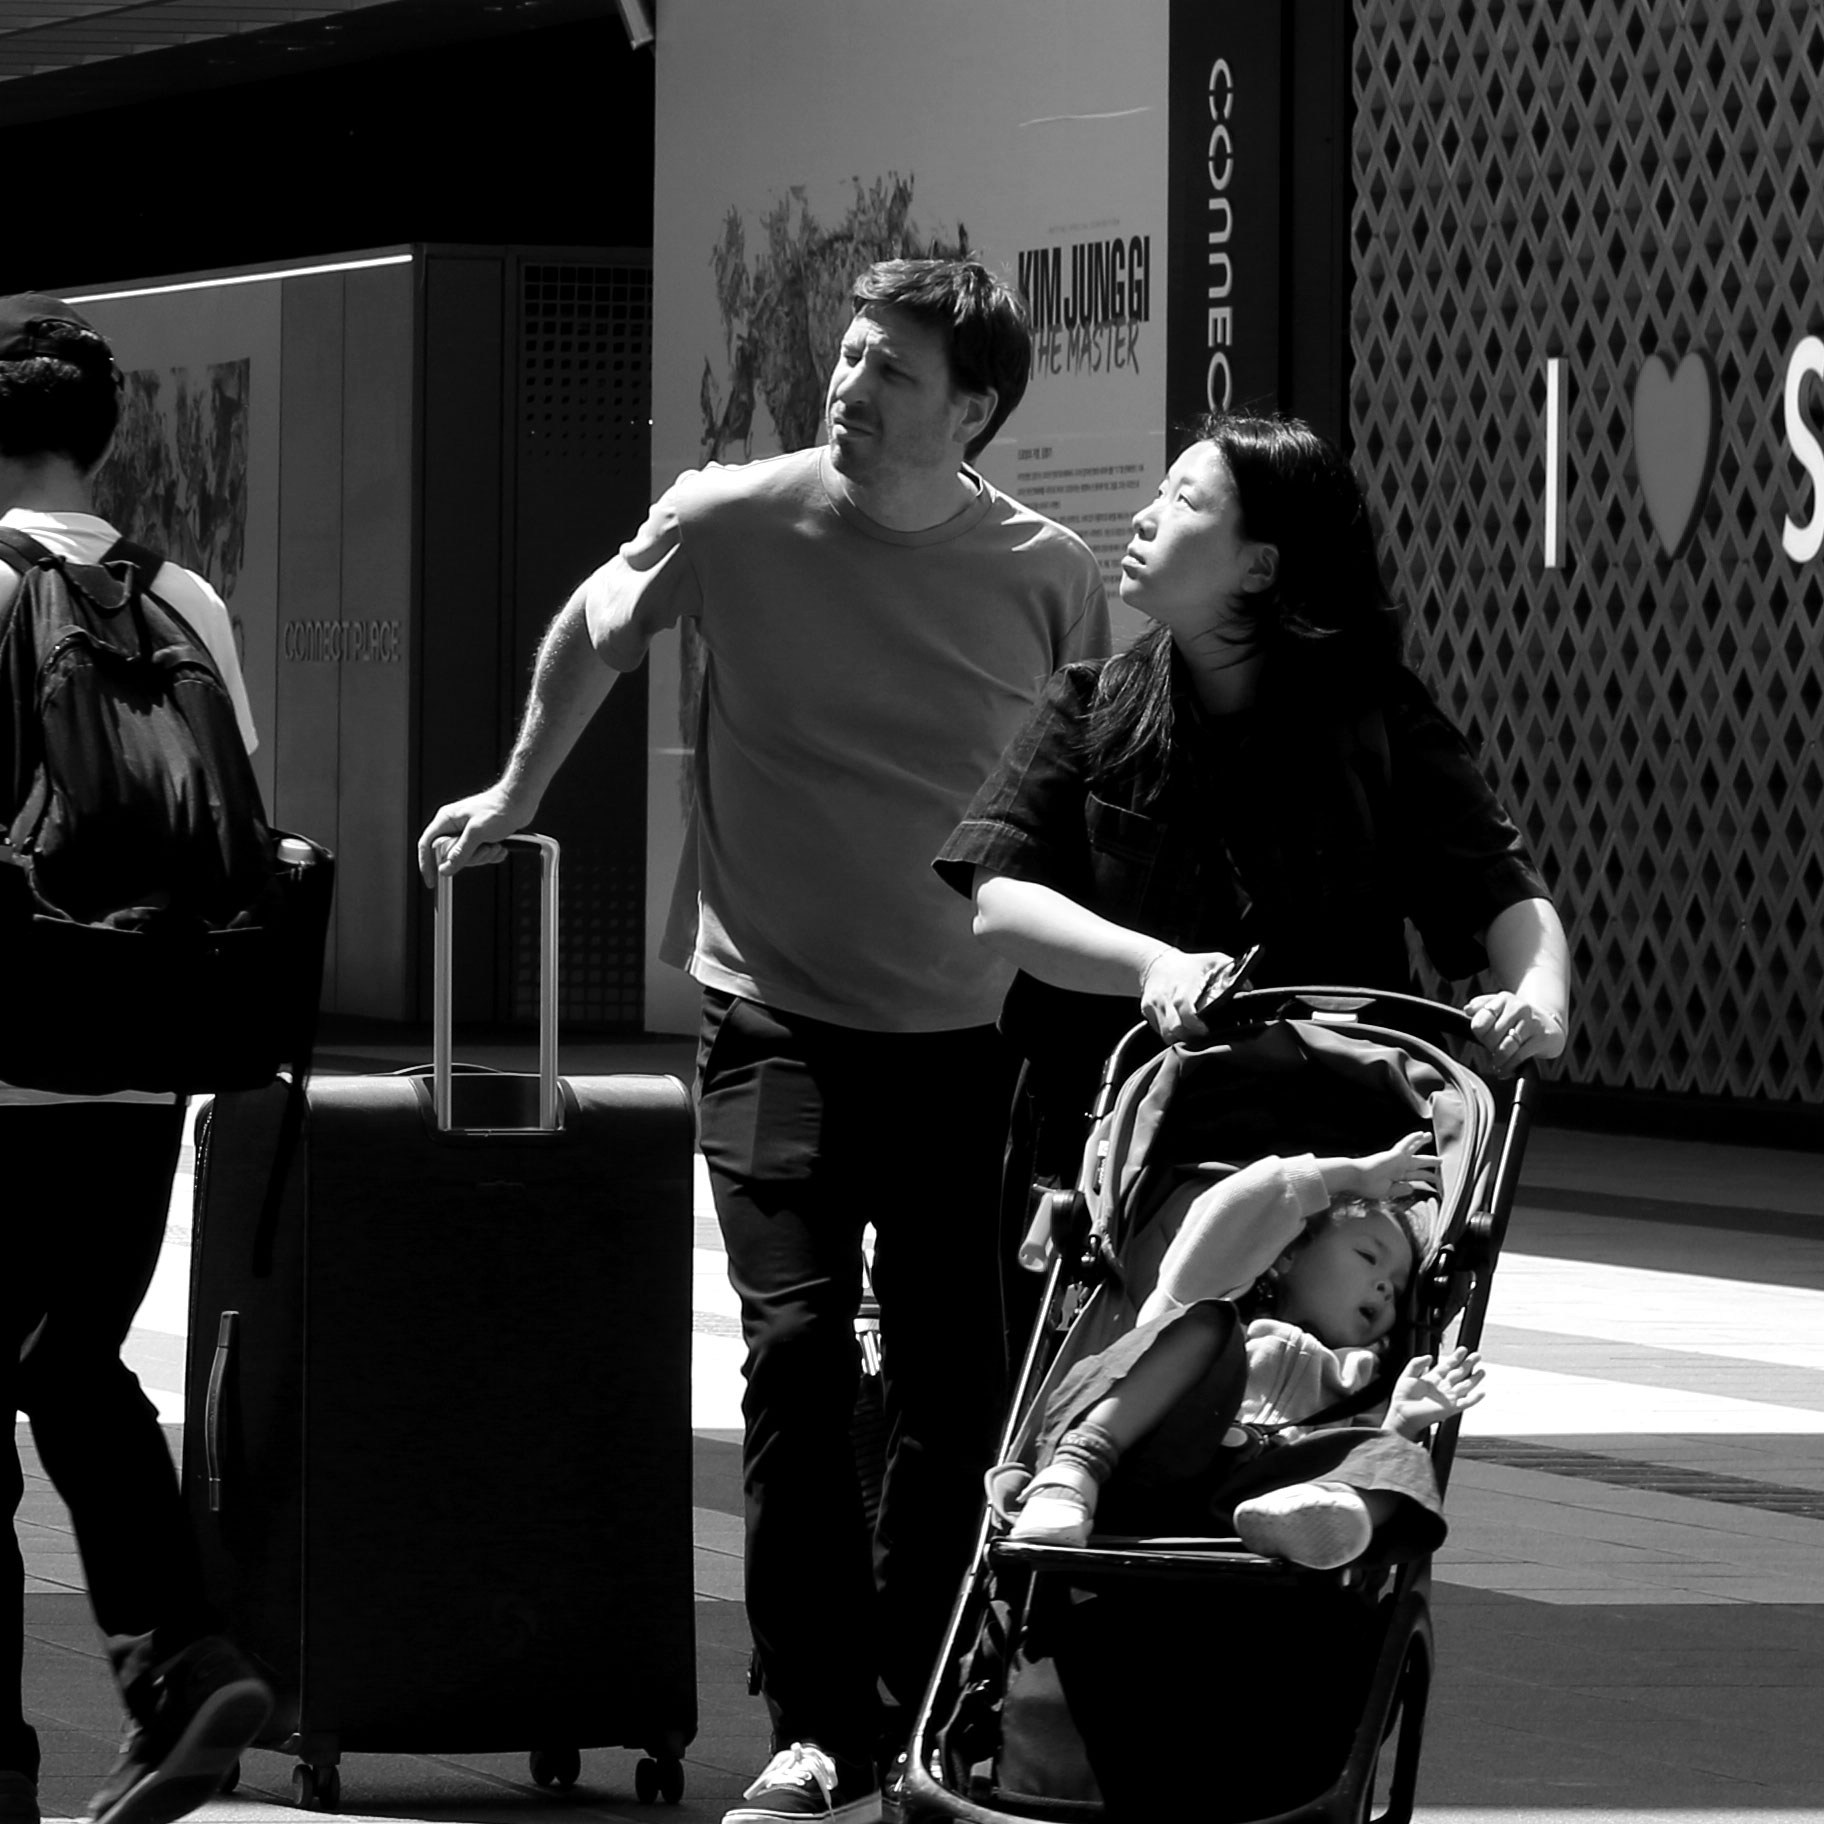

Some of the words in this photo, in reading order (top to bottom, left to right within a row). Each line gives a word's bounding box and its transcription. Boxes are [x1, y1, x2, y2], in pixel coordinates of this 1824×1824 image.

[1207, 56, 1234, 414] CONNEC
[1018, 247, 1062, 330] KIM
[1063, 238, 1126, 331] JUNG
[1128, 235, 1150, 323] GI
[1029, 324, 1062, 380] THE
[1065, 316, 1139, 376] MASTER
[284, 620, 350, 662] CONNECT
[353, 620, 401, 662] PLACE
